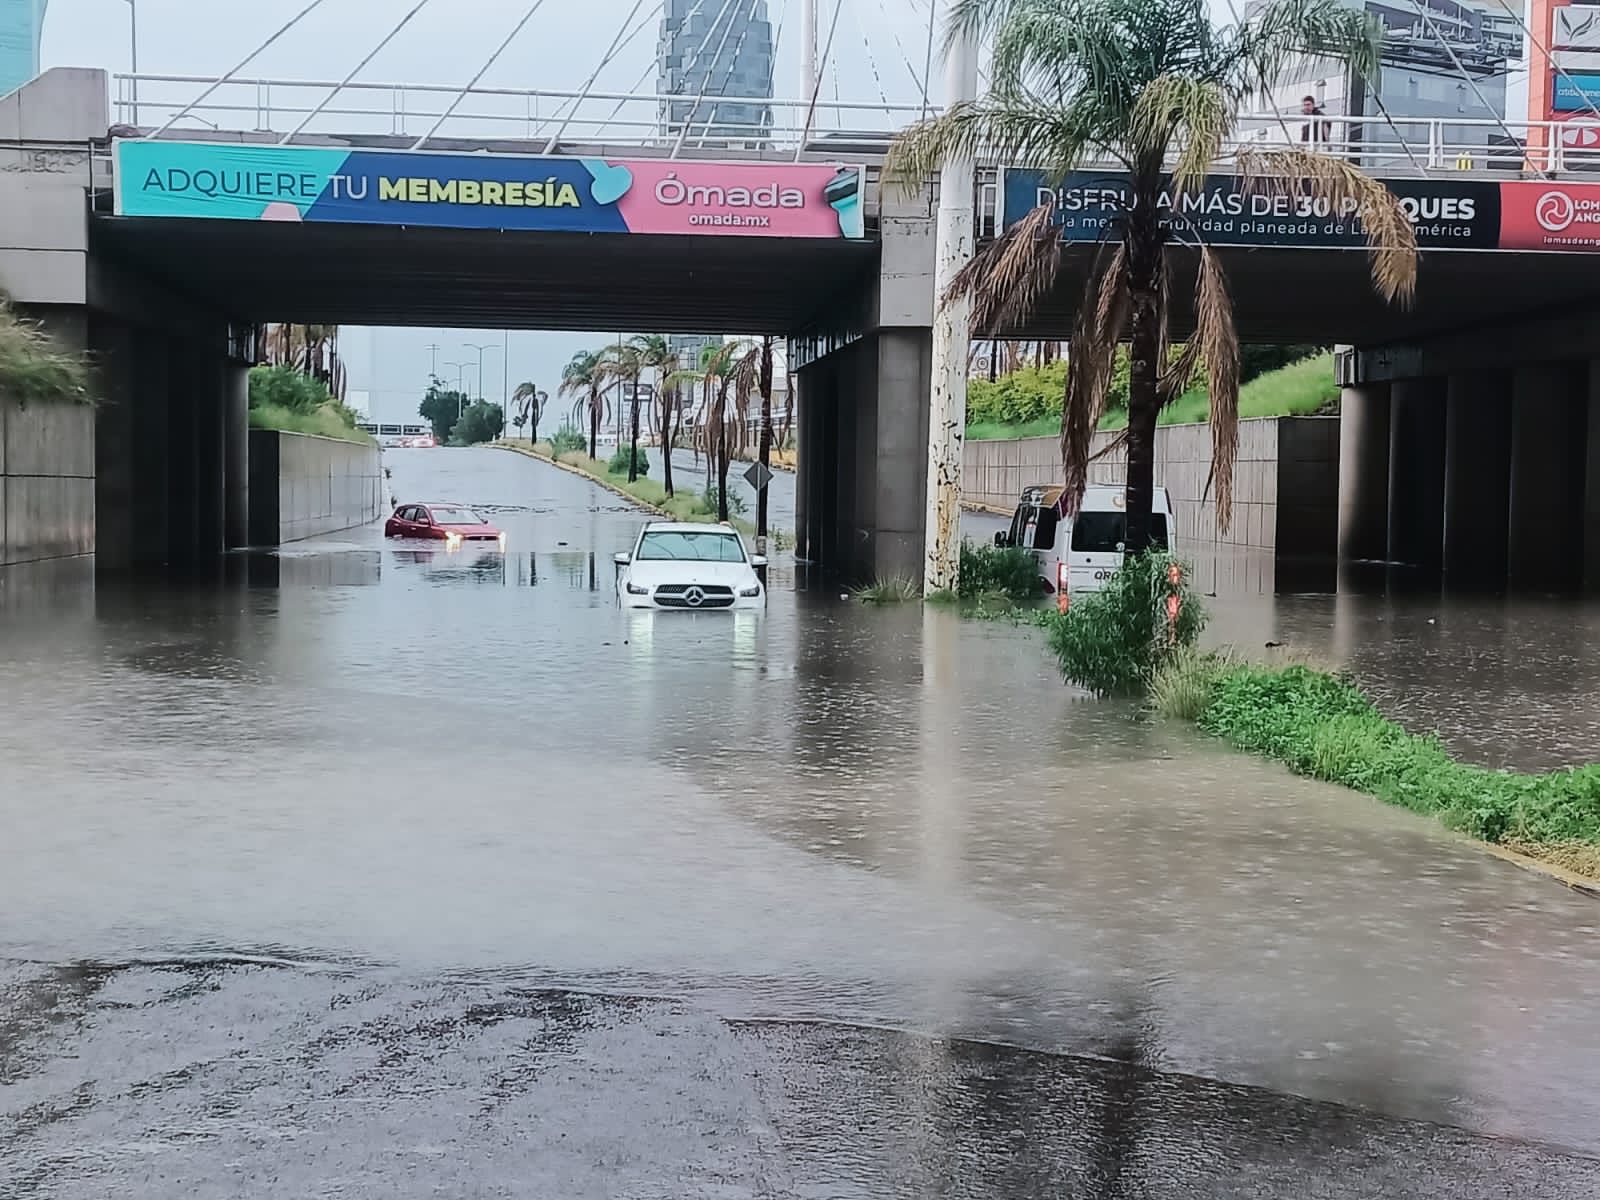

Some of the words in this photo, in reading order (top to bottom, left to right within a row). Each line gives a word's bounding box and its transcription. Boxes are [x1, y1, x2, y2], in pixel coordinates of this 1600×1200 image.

[142, 168, 317, 197] ADQUIERE
[327, 174, 368, 199] TU
[377, 176, 580, 208] MEMBRESÍA
[655, 172, 805, 208] Ómada
[1036, 187, 1174, 213] DISFRUA
[1182, 188, 1242, 215] MÁS
[1251, 194, 1289, 217] DE
[1296, 195, 1331, 217] 30
[688, 211, 770, 227] omada.mx
[1240, 219, 1317, 235] planeada
[1323, 221, 1344, 234] de
